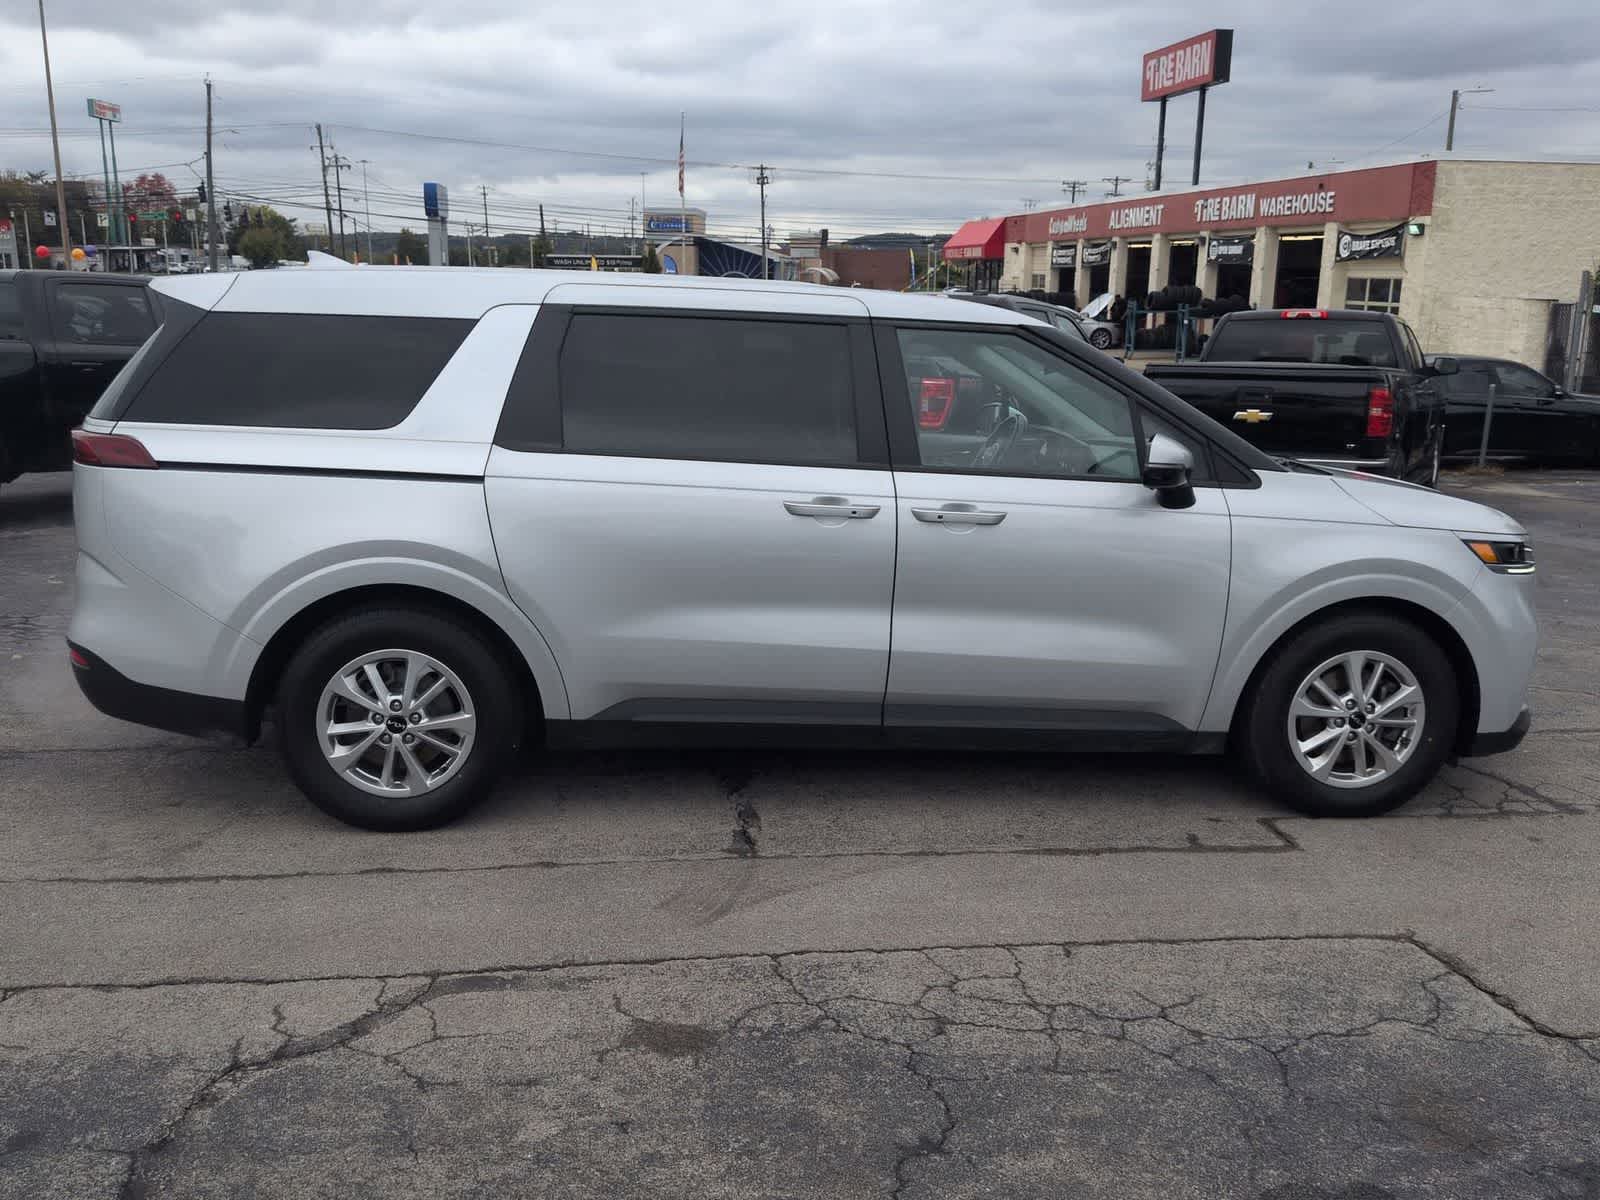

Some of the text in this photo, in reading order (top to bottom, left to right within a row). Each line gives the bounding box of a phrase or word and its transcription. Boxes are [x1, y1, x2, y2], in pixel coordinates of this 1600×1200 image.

[1175, 39, 1212, 84] BARN
[1109, 204, 1164, 230] ALIGNMENT
[1221, 193, 1256, 220] BARN
[1259, 191, 1335, 217] WAREHOUSE
